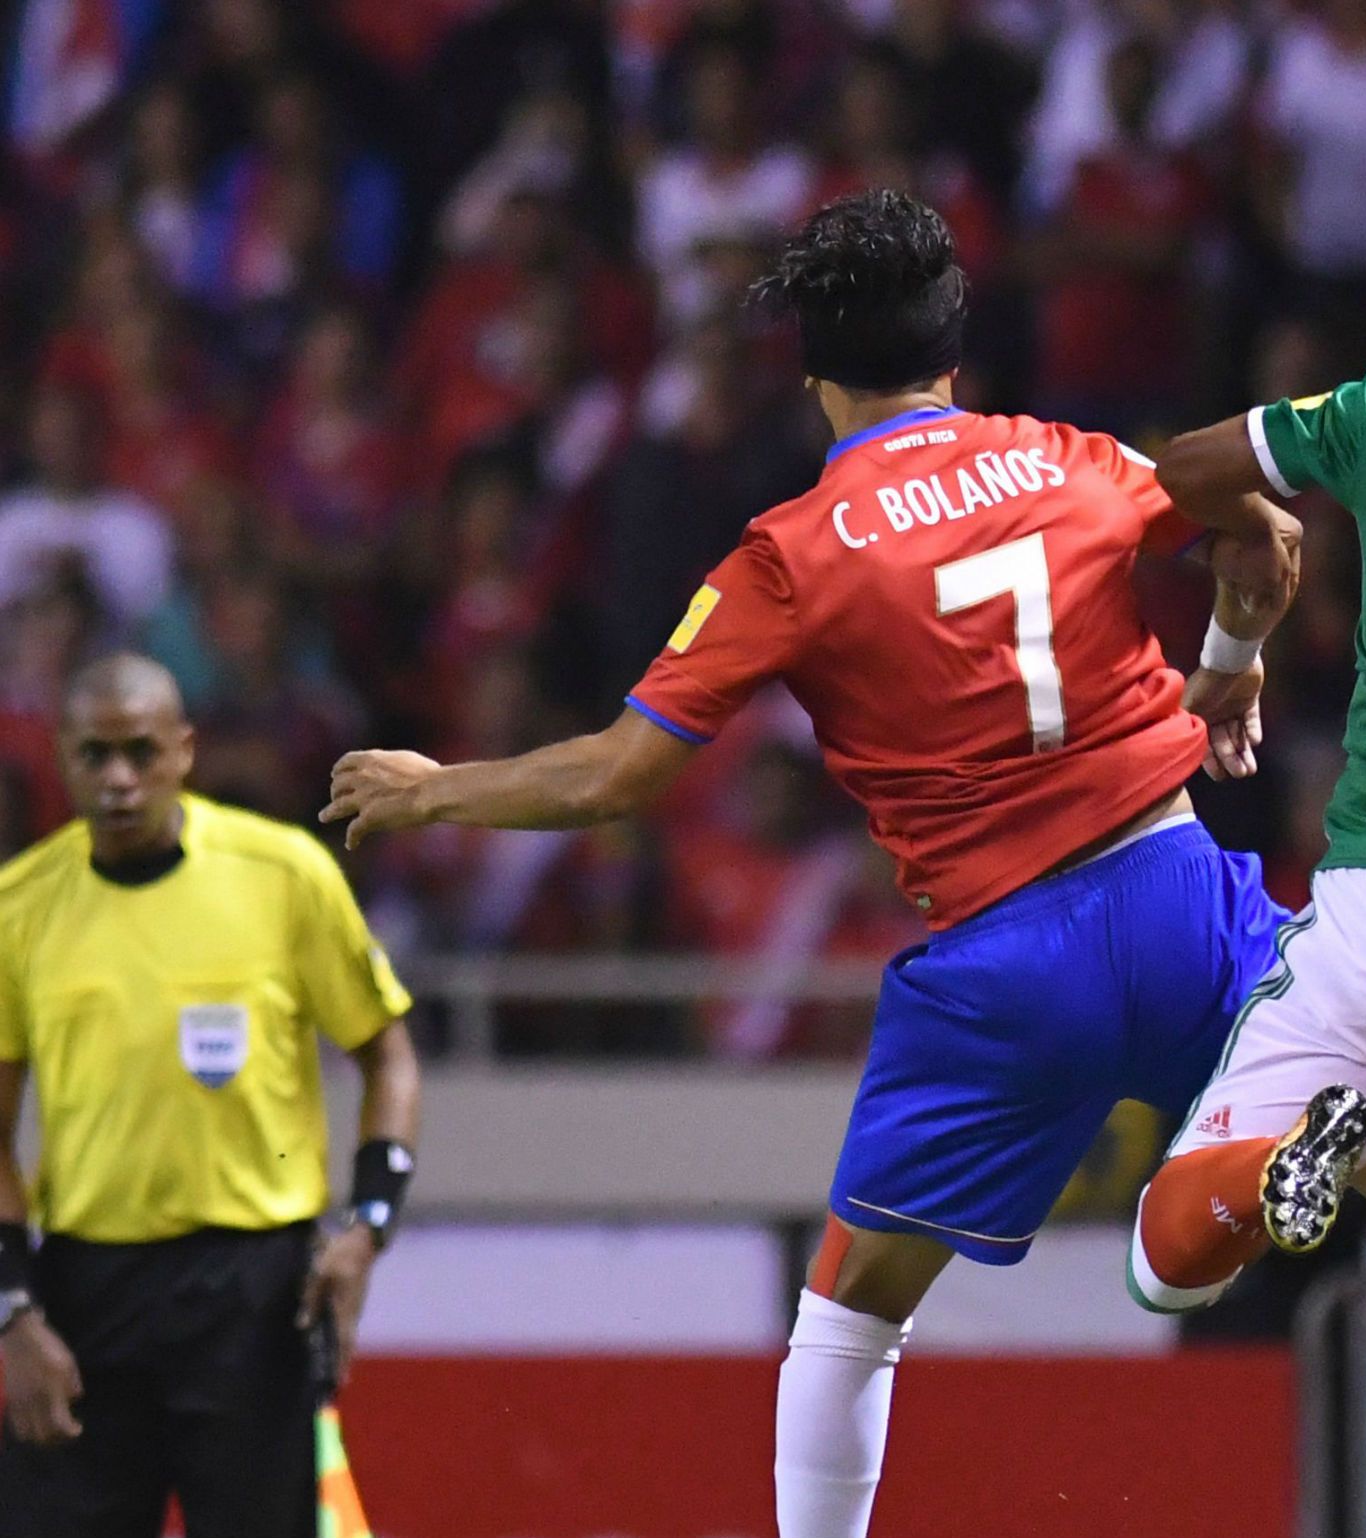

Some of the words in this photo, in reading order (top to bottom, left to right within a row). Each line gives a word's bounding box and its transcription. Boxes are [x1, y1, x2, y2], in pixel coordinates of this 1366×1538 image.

[884, 433, 926, 452] COSTA
[927, 429, 957, 445] RICA
[832, 501, 879, 549] C.
[876, 448, 1065, 533] BOLAÑOS
[934, 532, 1066, 753] 7
